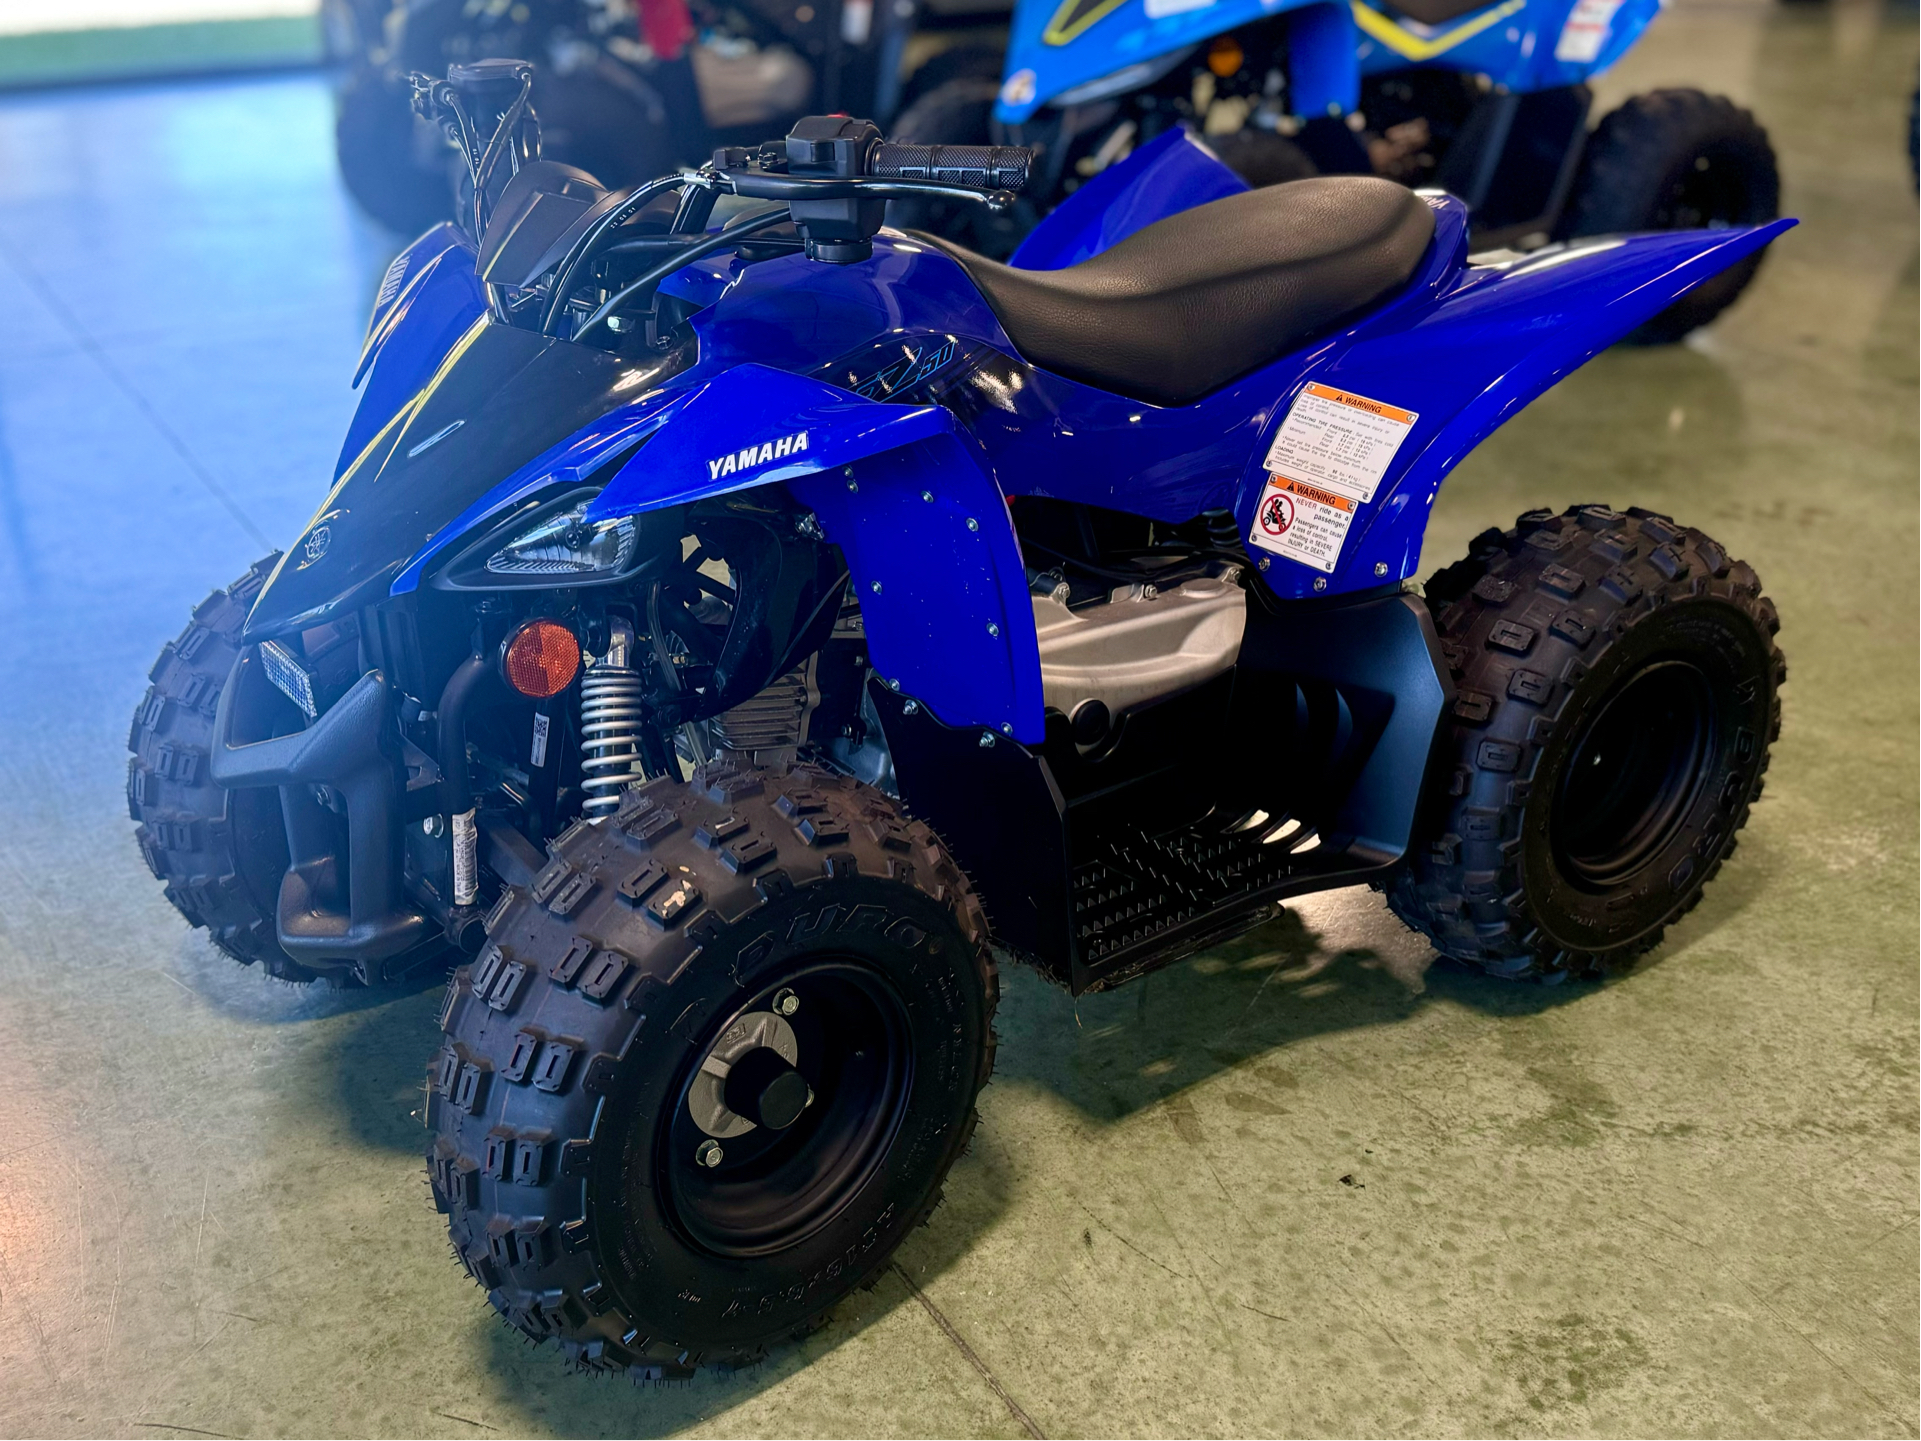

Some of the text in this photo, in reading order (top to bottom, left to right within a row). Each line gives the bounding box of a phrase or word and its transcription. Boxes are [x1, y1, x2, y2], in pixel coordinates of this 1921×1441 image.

[378, 256, 410, 308] YAMAHA
[1344, 397, 1382, 413] WARNING
[708, 432, 808, 480] YAMAHA
[1295, 484, 1336, 505] WARNING
[1295, 497, 1317, 510] NEVER
[1319, 506, 1332, 515] ride
[1294, 517, 1319, 531] Passengers
[1313, 513, 1346, 530] passenger.
[1287, 538, 1303, 548] INJURY
[1314, 540, 1332, 551] SEVERE
